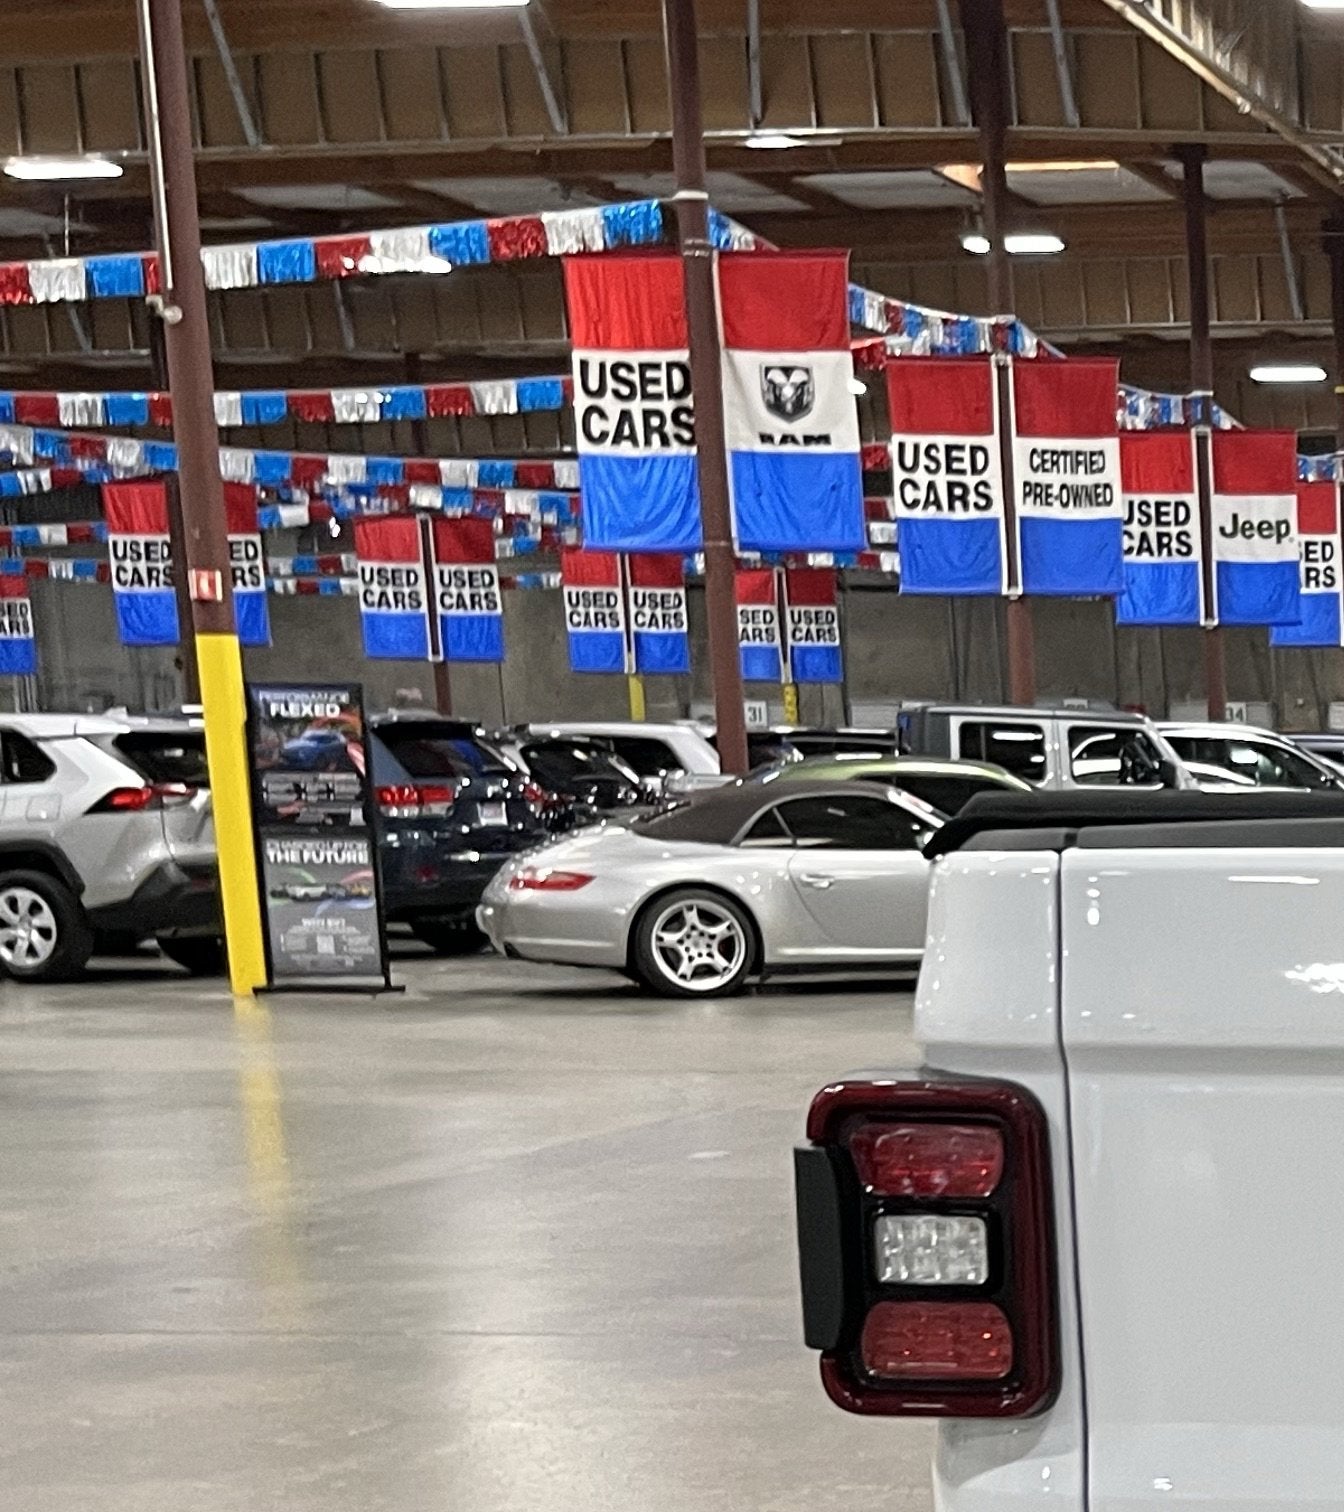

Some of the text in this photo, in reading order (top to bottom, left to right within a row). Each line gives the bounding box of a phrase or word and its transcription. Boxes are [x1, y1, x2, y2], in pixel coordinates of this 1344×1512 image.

[579, 358, 692, 402] USED
[581, 404, 697, 448] CARS
[758, 431, 832, 446] RAM
[898, 441, 989, 476] USED
[1029, 448, 1105, 475] CERTIFIED
[899, 478, 993, 512] CARS
[1022, 481, 1114, 508] PRE-OWNED
[1218, 512, 1291, 545] Jeep
[112, 540, 171, 562] USED
[360, 566, 419, 588] USED
[439, 568, 495, 589] USED
[362, 588, 422, 610] CARS
[439, 591, 498, 611] CARS
[567, 591, 618, 609] USED
[633, 591, 683, 610] USED
[569, 610, 620, 628] CARS
[634, 611, 684, 629] CARS
[740, 609, 774, 625] SED
[790, 609, 835, 626] USED
[740, 628, 775, 643] ARS
[791, 628, 837, 643] CARS
